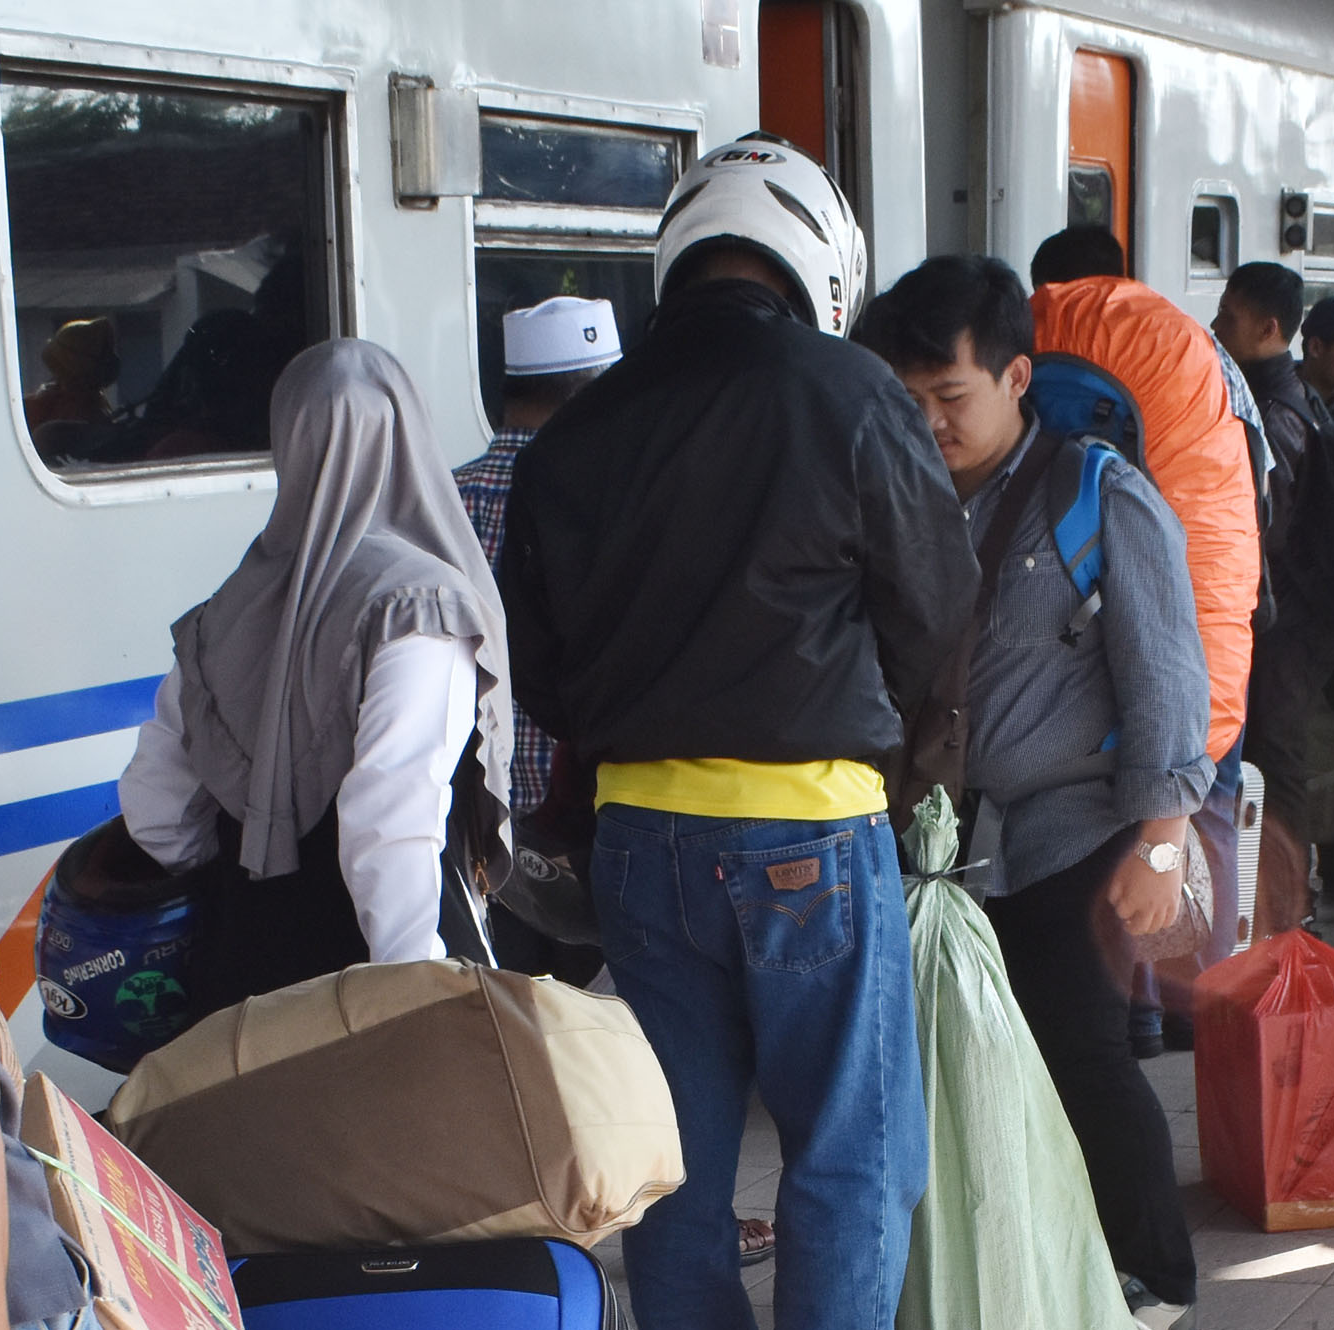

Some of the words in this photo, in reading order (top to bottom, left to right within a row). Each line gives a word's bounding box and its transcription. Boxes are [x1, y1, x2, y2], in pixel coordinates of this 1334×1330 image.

[720, 150, 773, 163] GM
[829, 275, 842, 331] GM
[63, 949, 126, 986] CORNERING
